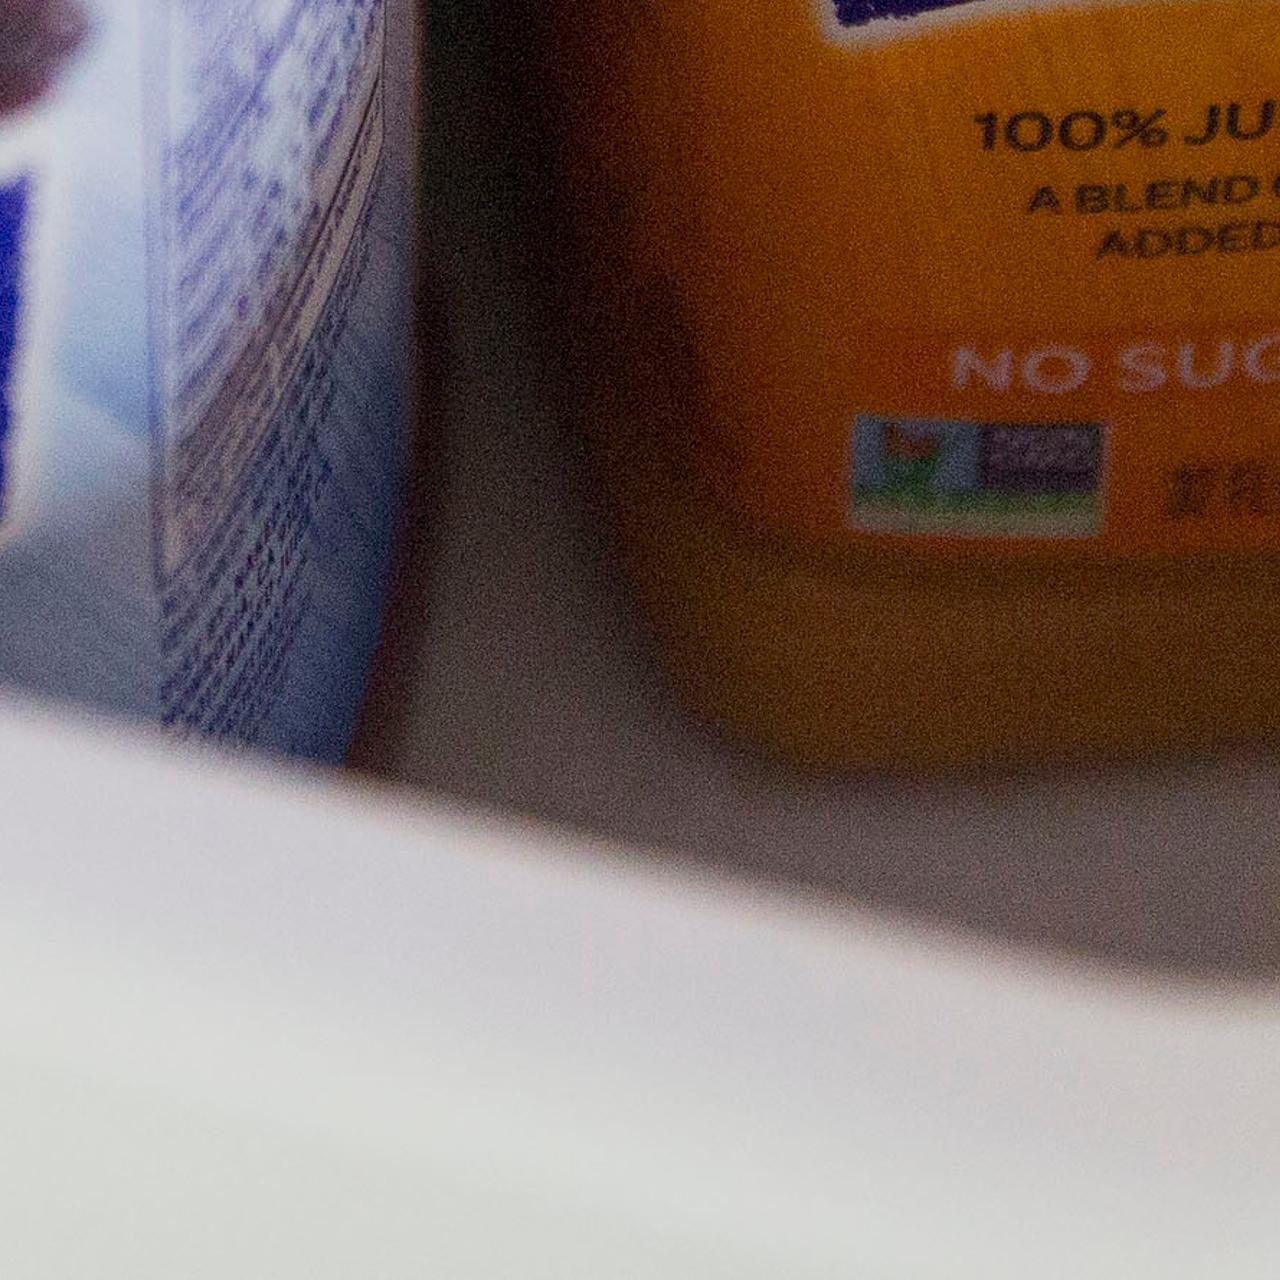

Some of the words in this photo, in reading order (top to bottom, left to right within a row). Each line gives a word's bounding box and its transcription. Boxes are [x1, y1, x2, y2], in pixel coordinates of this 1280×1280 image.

[973, 108, 1168, 153] 100%
[1026, 184, 1062, 215] A
[1072, 173, 1260, 215] BLEND
[949, 341, 1092, 394] NO
